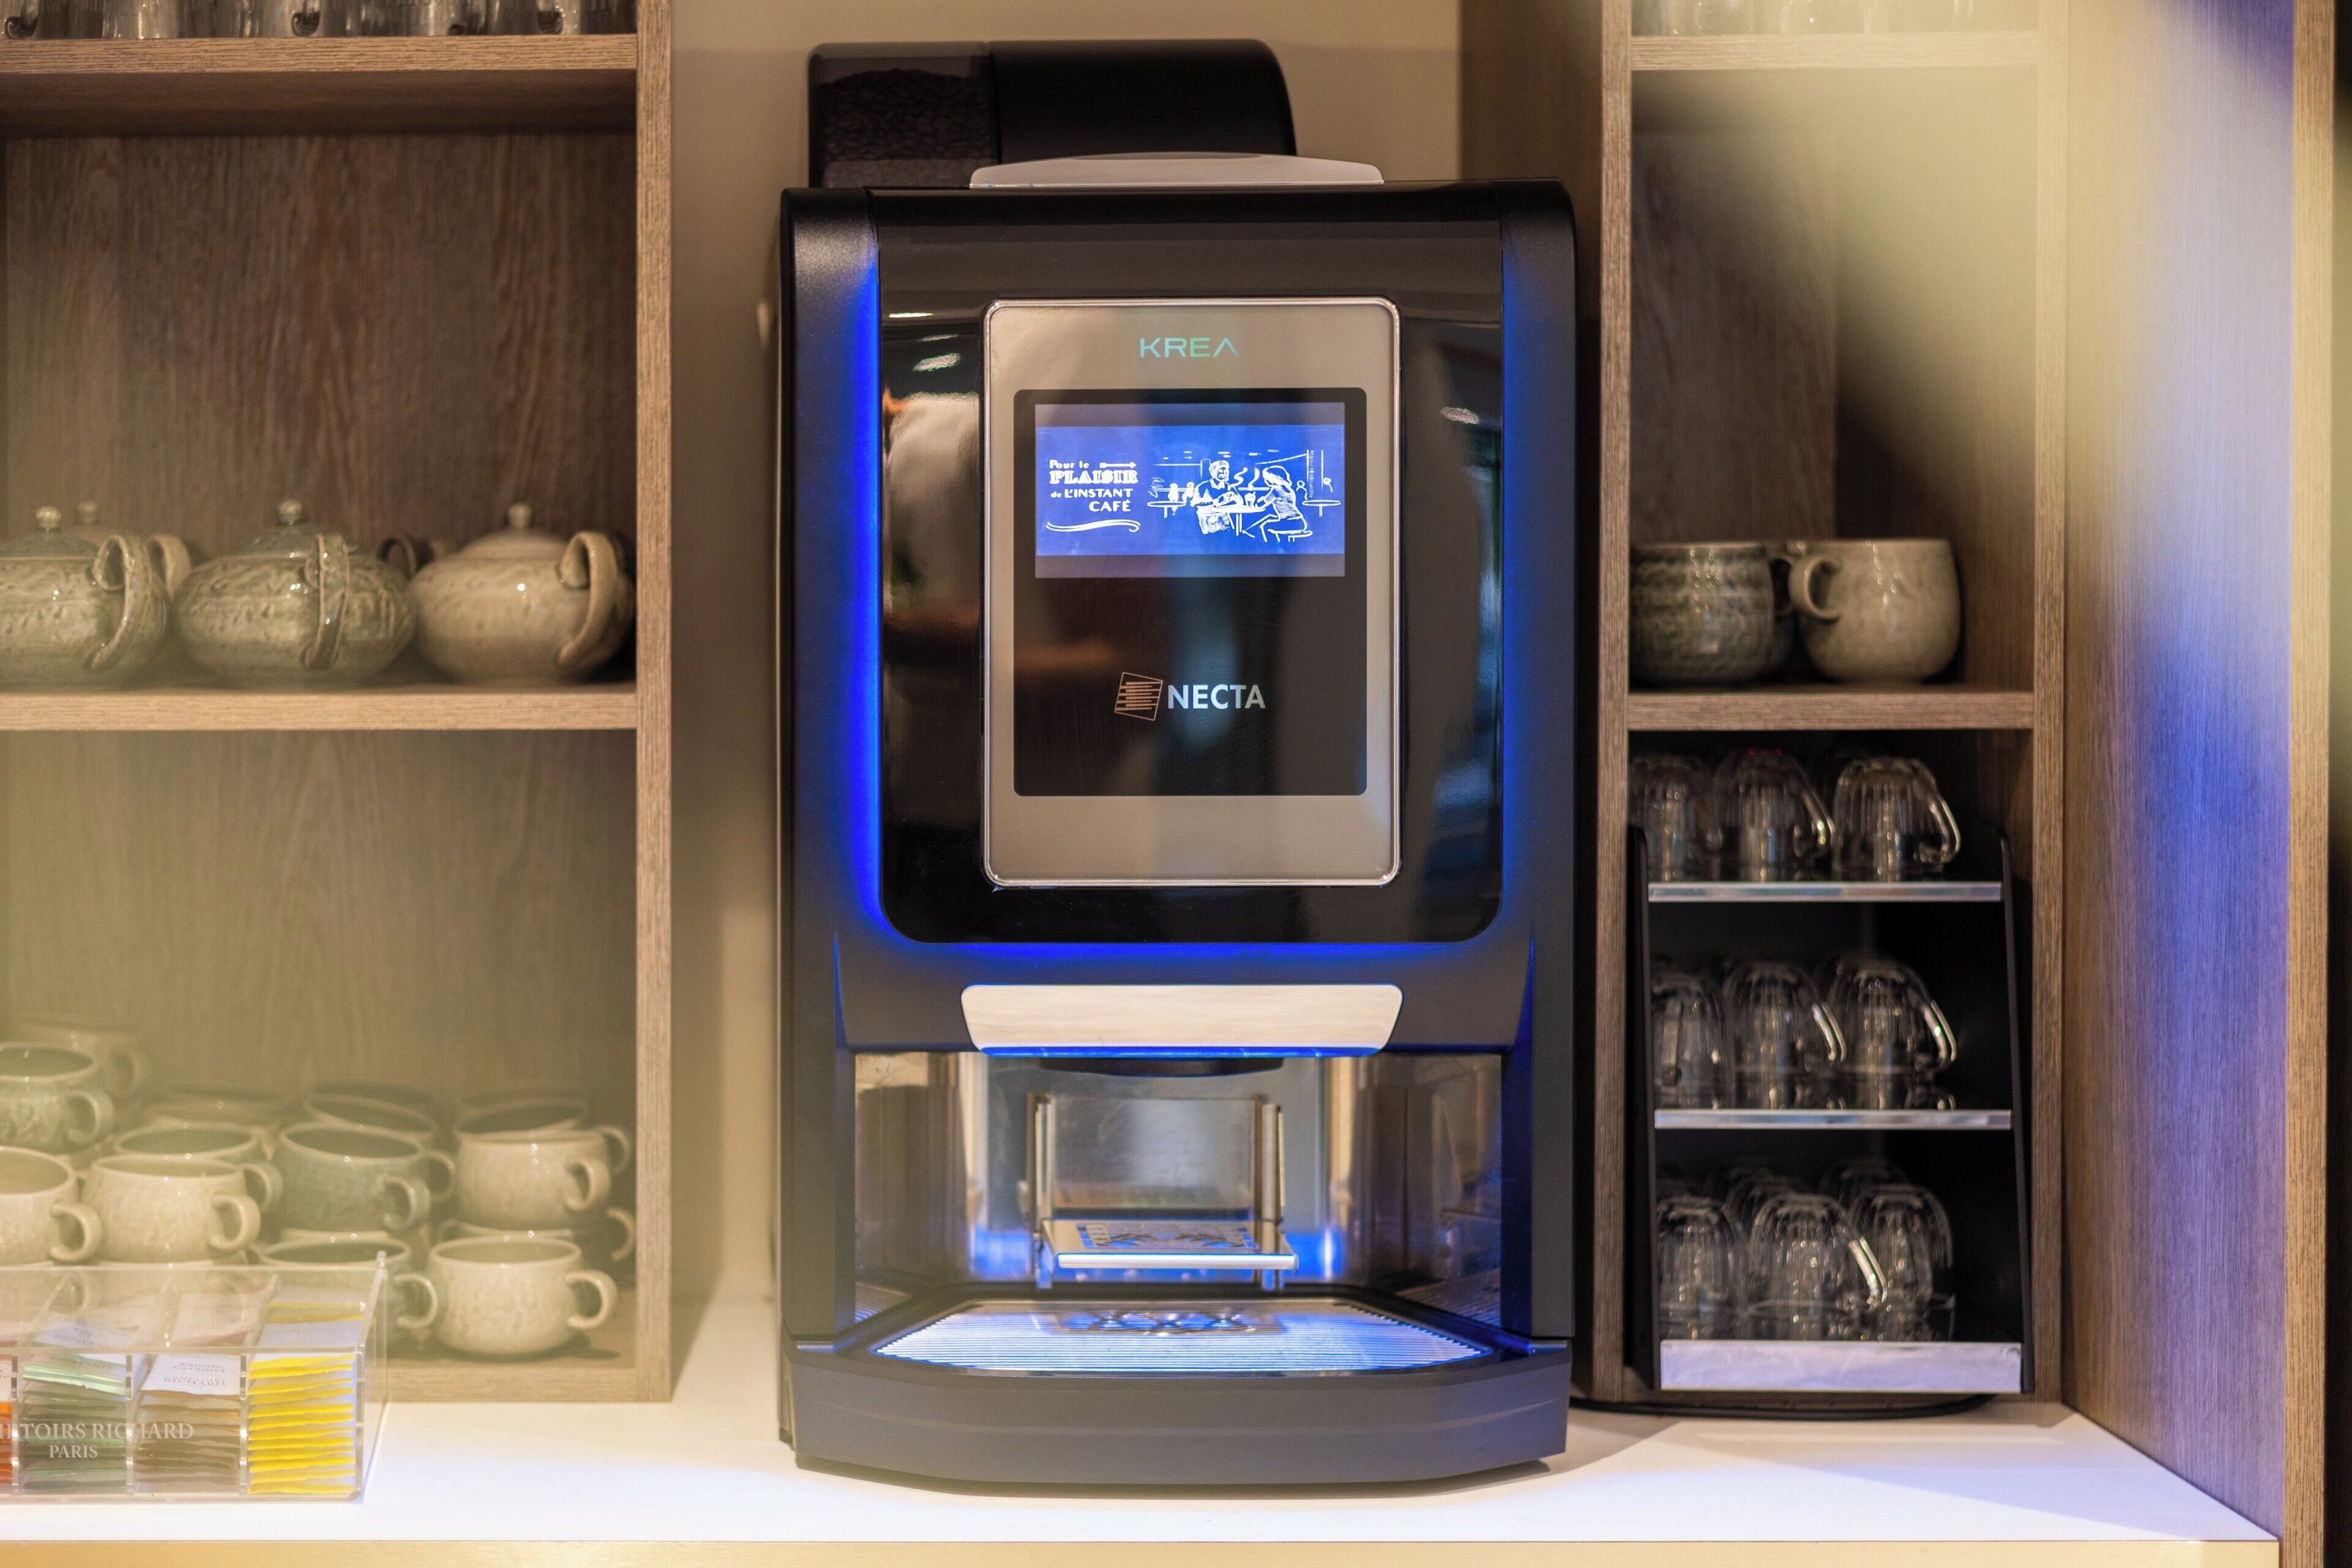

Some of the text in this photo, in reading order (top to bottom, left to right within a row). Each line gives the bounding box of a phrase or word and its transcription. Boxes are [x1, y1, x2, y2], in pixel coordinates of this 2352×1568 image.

[1140, 337, 1239, 358] KREA
[1049, 459, 1090, 469] Pour le
[1049, 469, 1139, 484] PLAISIR
[1064, 488, 1133, 498] L'INSTANT
[1088, 499, 1131, 512] CAFÉ
[1167, 684, 1266, 710] NECTA
[92, 1423, 194, 1439] RICHARD
[49, 1445, 98, 1459] PARIS
